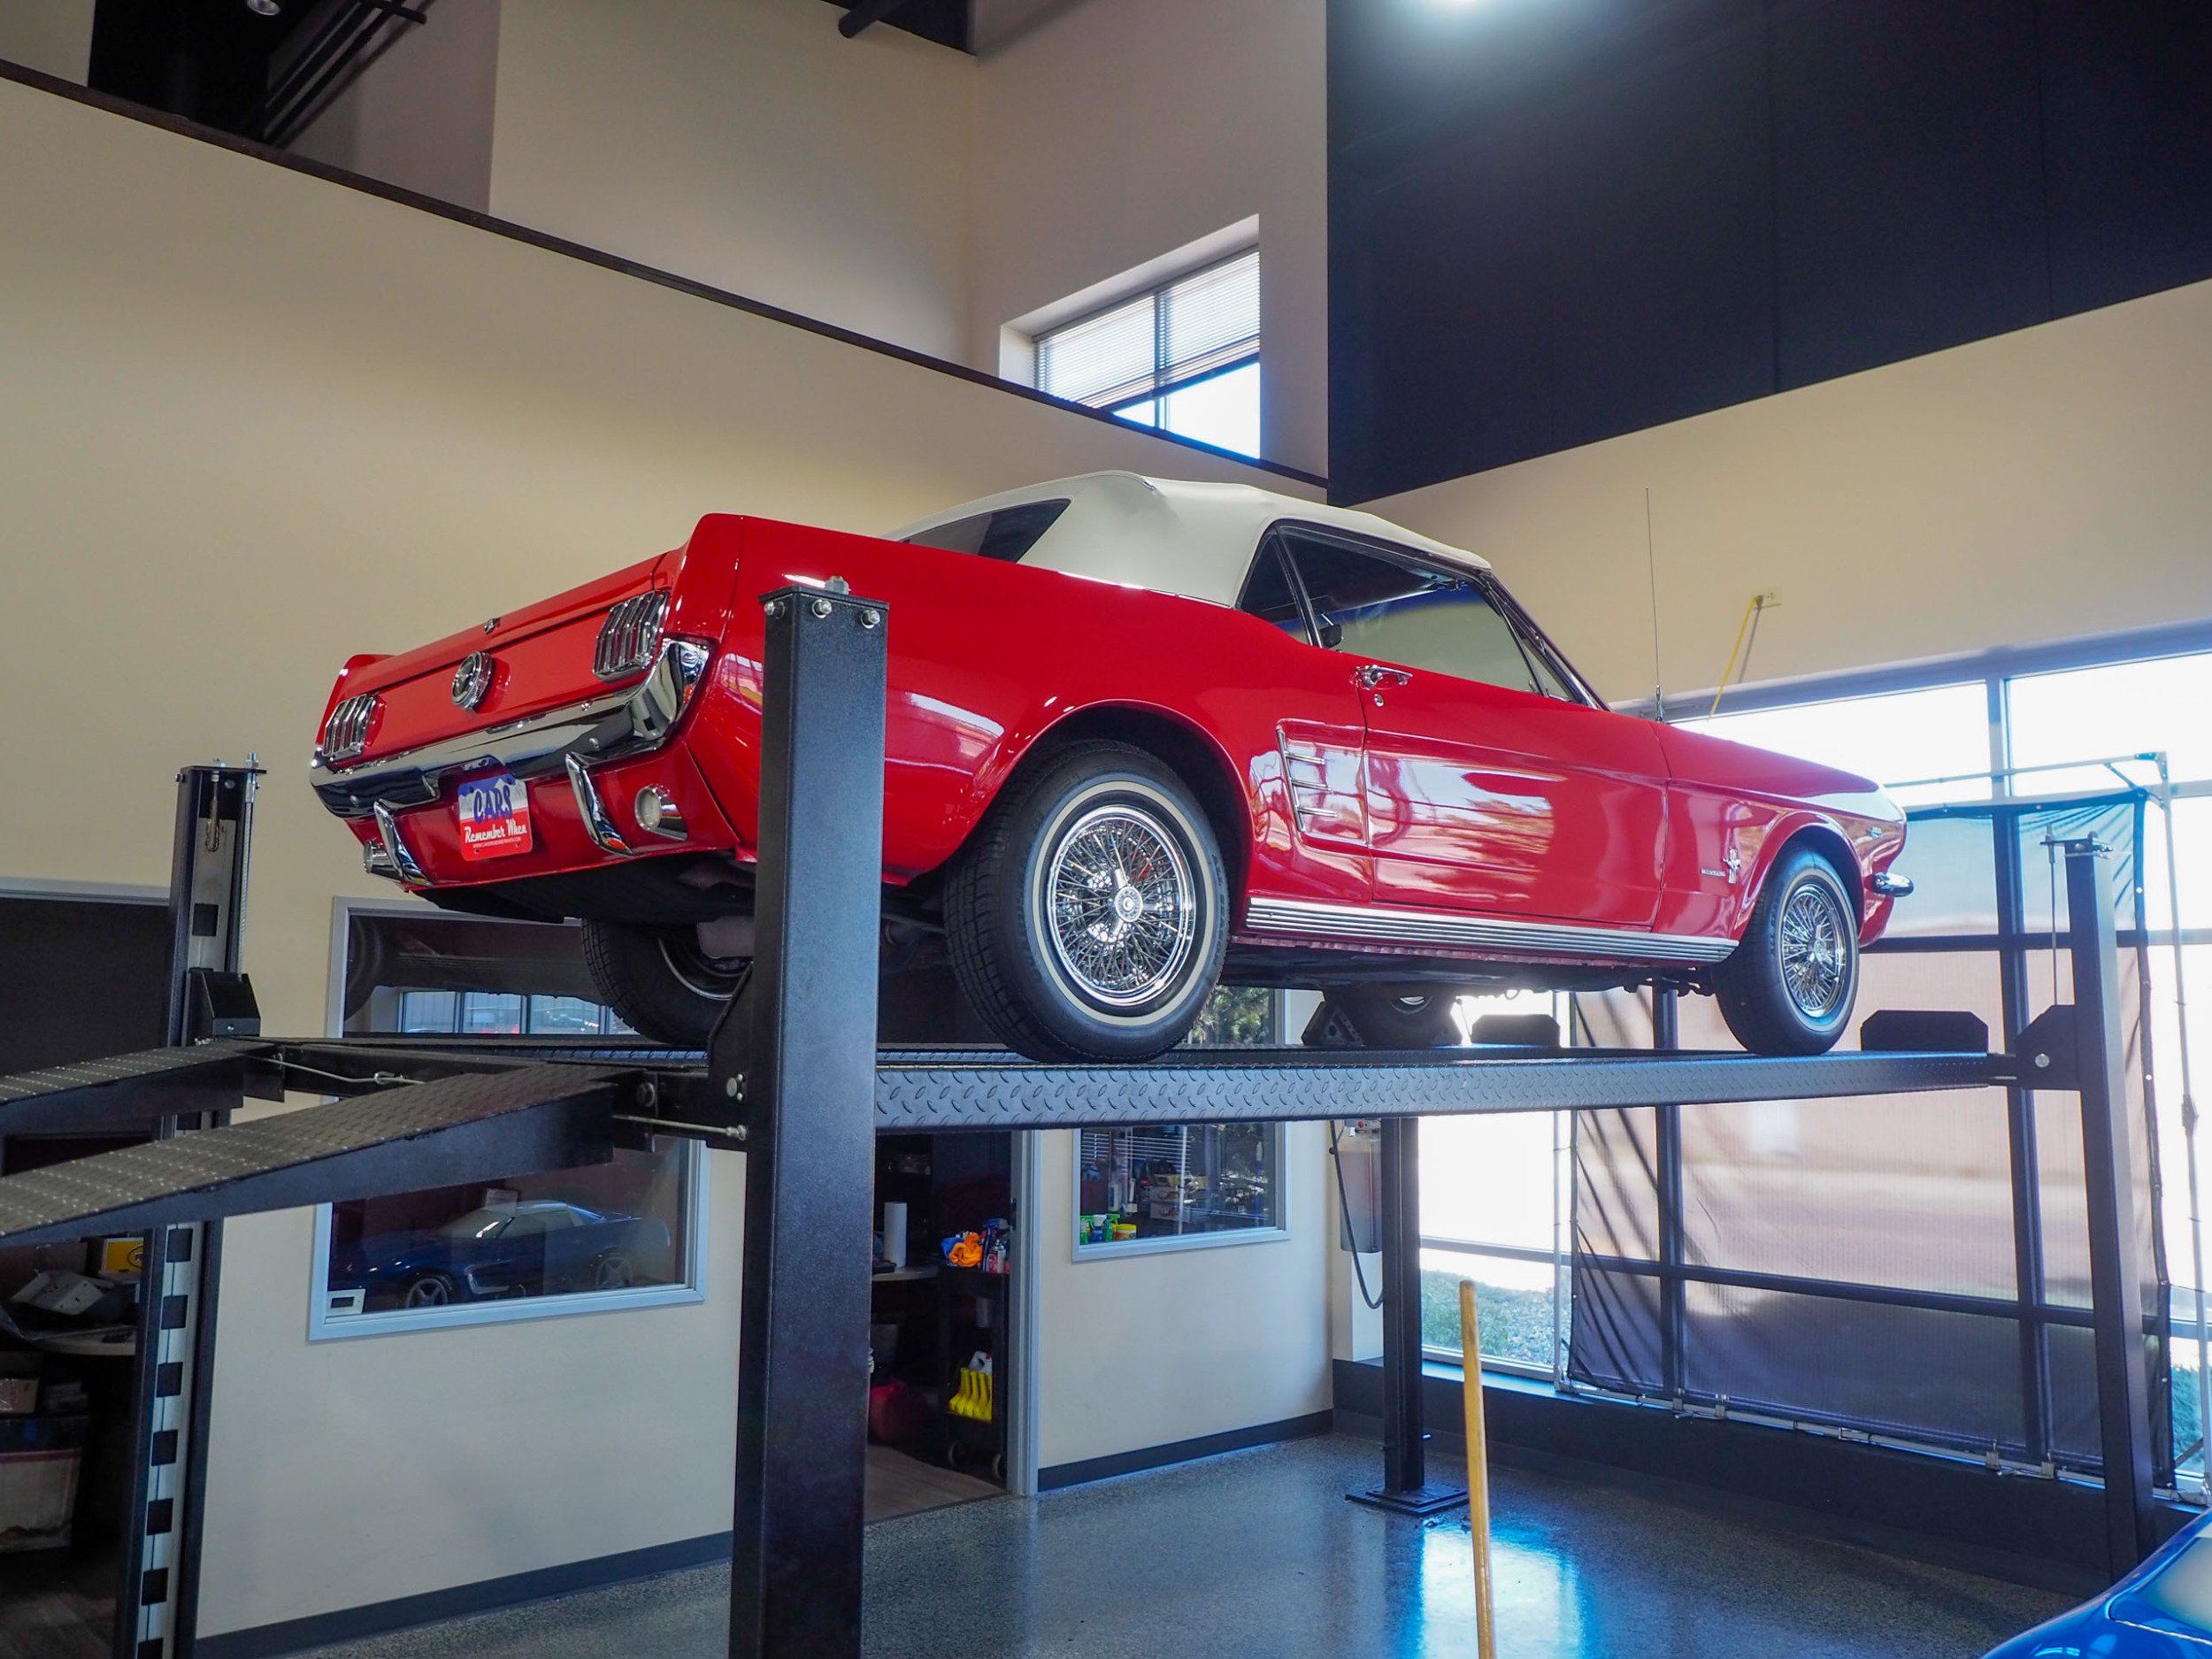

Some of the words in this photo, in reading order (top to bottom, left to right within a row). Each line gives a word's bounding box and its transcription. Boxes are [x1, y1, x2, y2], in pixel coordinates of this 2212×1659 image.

[473, 785, 512, 823] CARS
[465, 825, 505, 843] Remember
[506, 818, 527, 836] When
